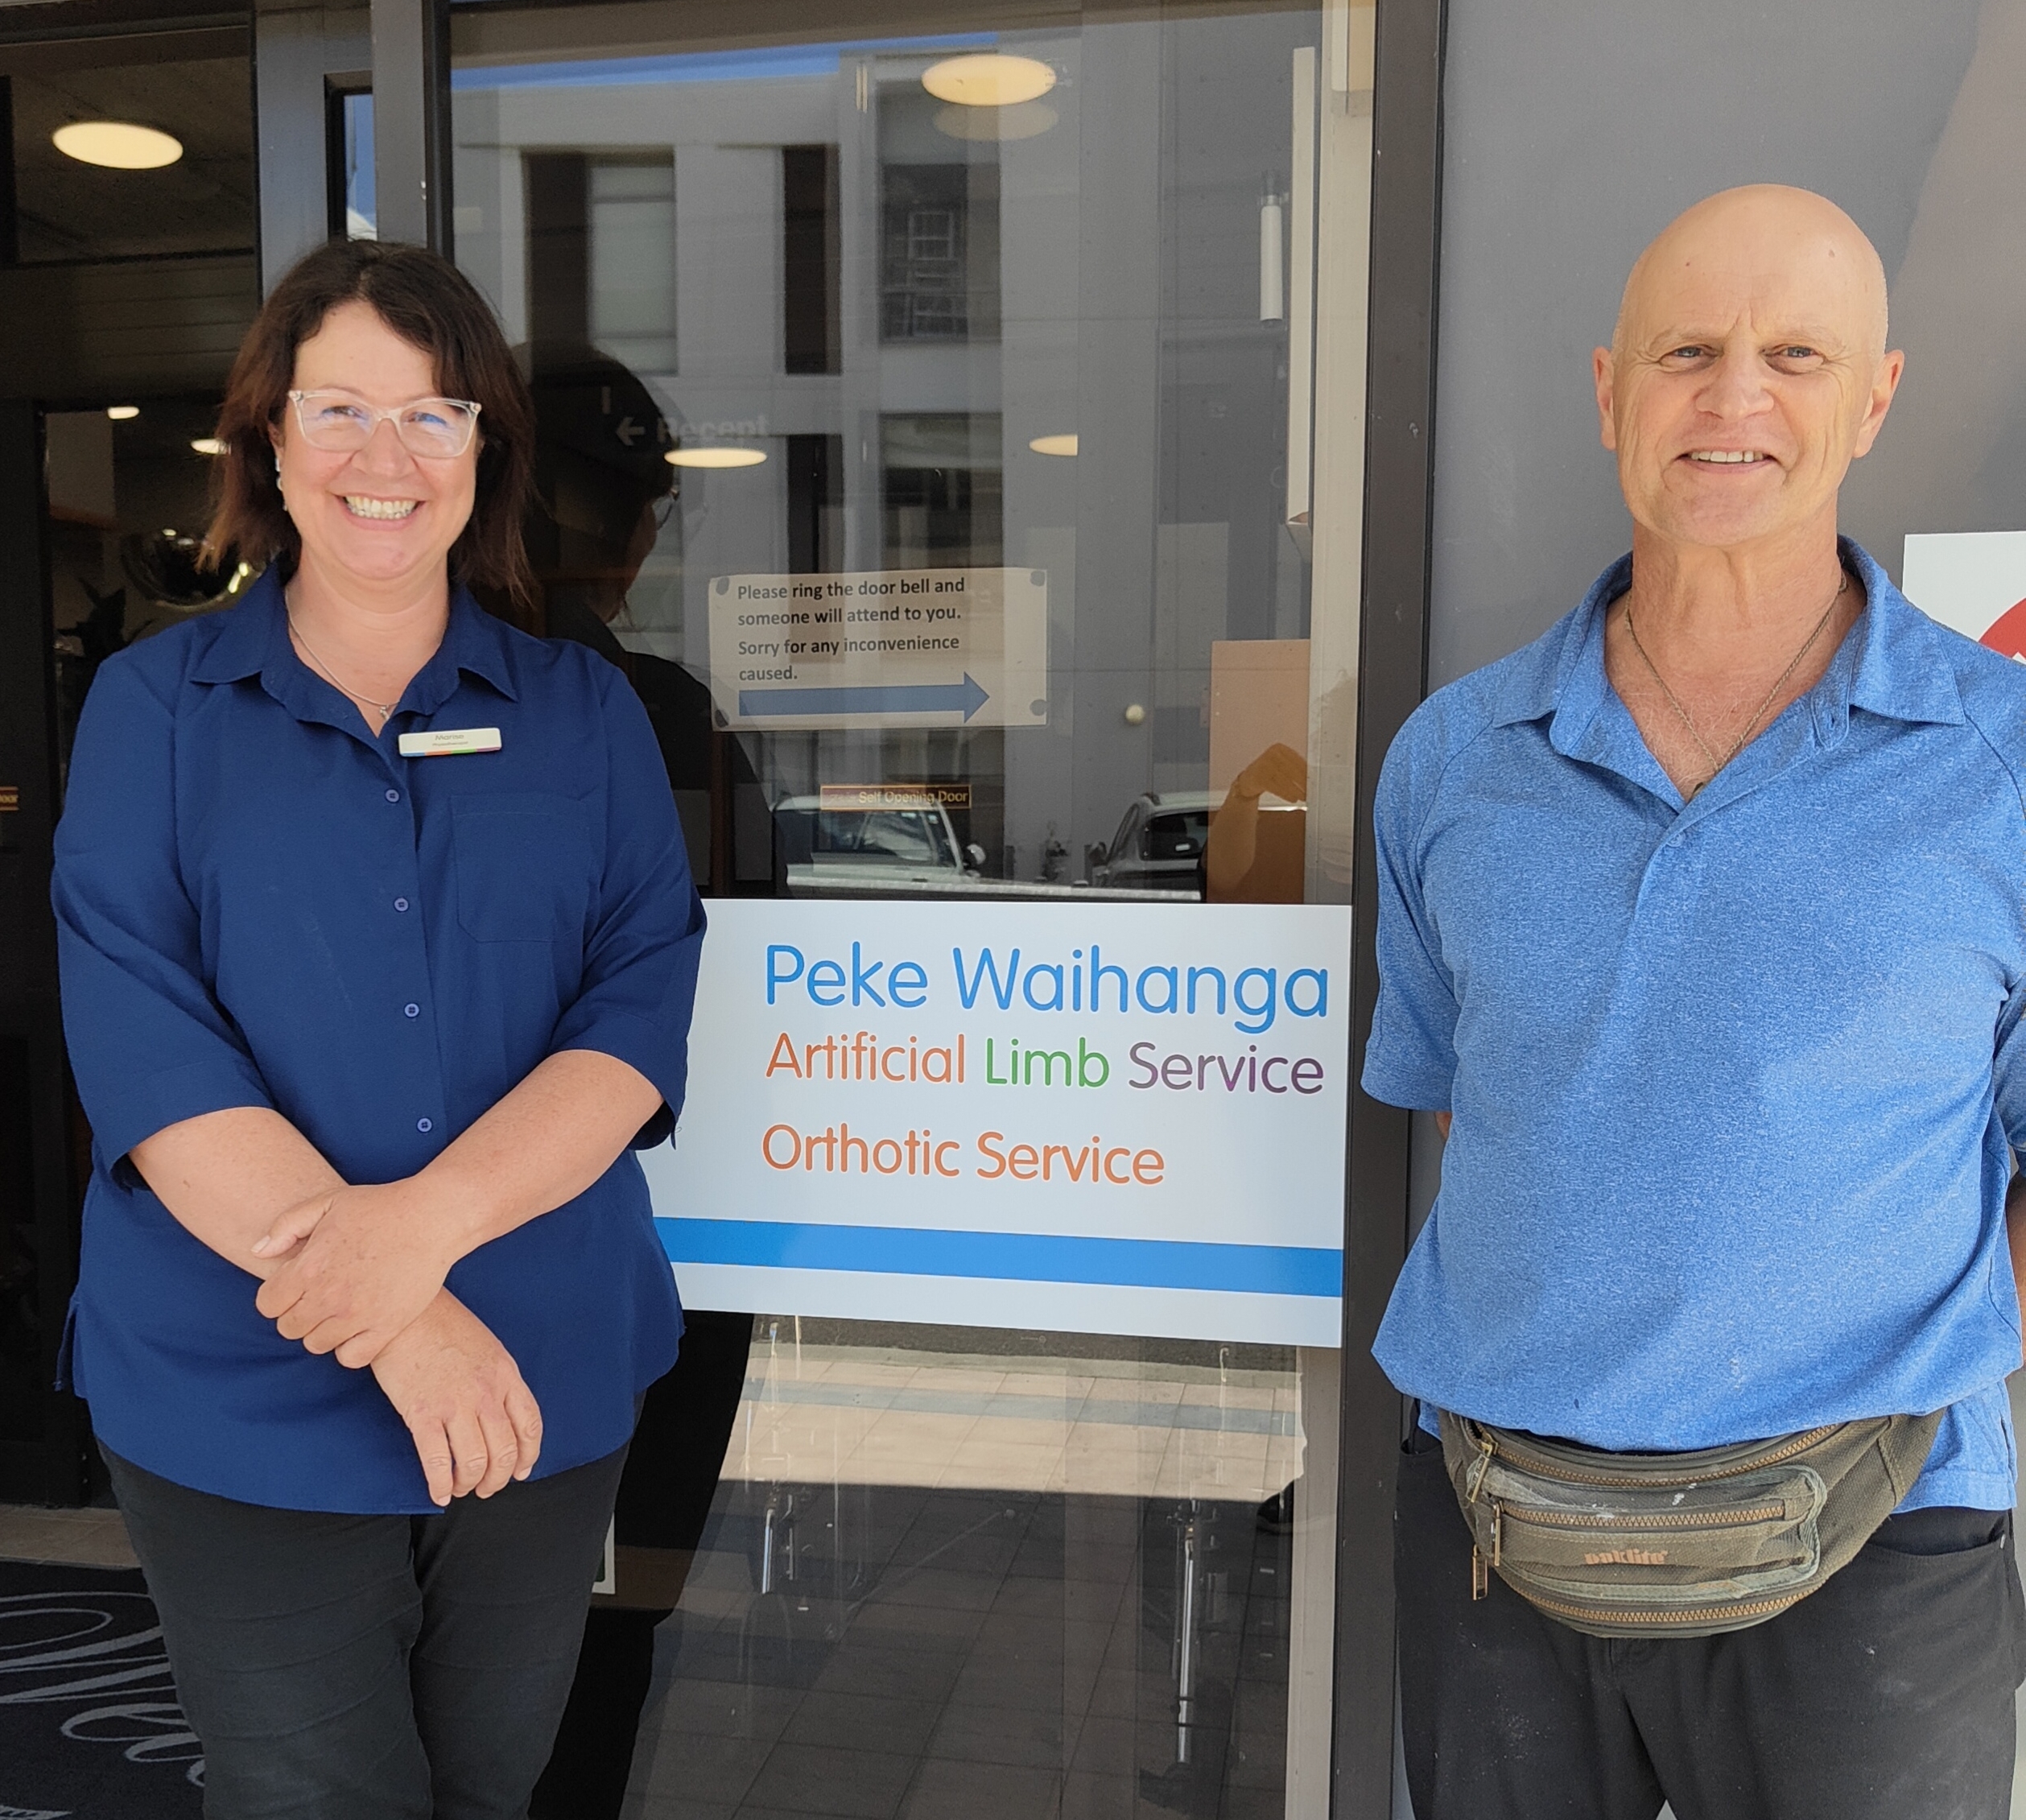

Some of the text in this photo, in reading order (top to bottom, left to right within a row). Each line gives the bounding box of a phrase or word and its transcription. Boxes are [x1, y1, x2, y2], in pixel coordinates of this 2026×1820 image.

[737, 576, 965, 601] Please ring the door bell and
[737, 605, 961, 626] someone will attend to you.
[737, 636, 959, 658] Sorry for any inconvenience
[738, 664, 798, 682] caused.
[858, 791, 882, 803] Self
[885, 790, 935, 804] Opening
[938, 790, 968, 803] Door
[765, 940, 1329, 1035] Peke Waihanga
[765, 1031, 1324, 1095] Artificial Limb Service
[762, 1123, 1165, 1185] Orthotic Service
